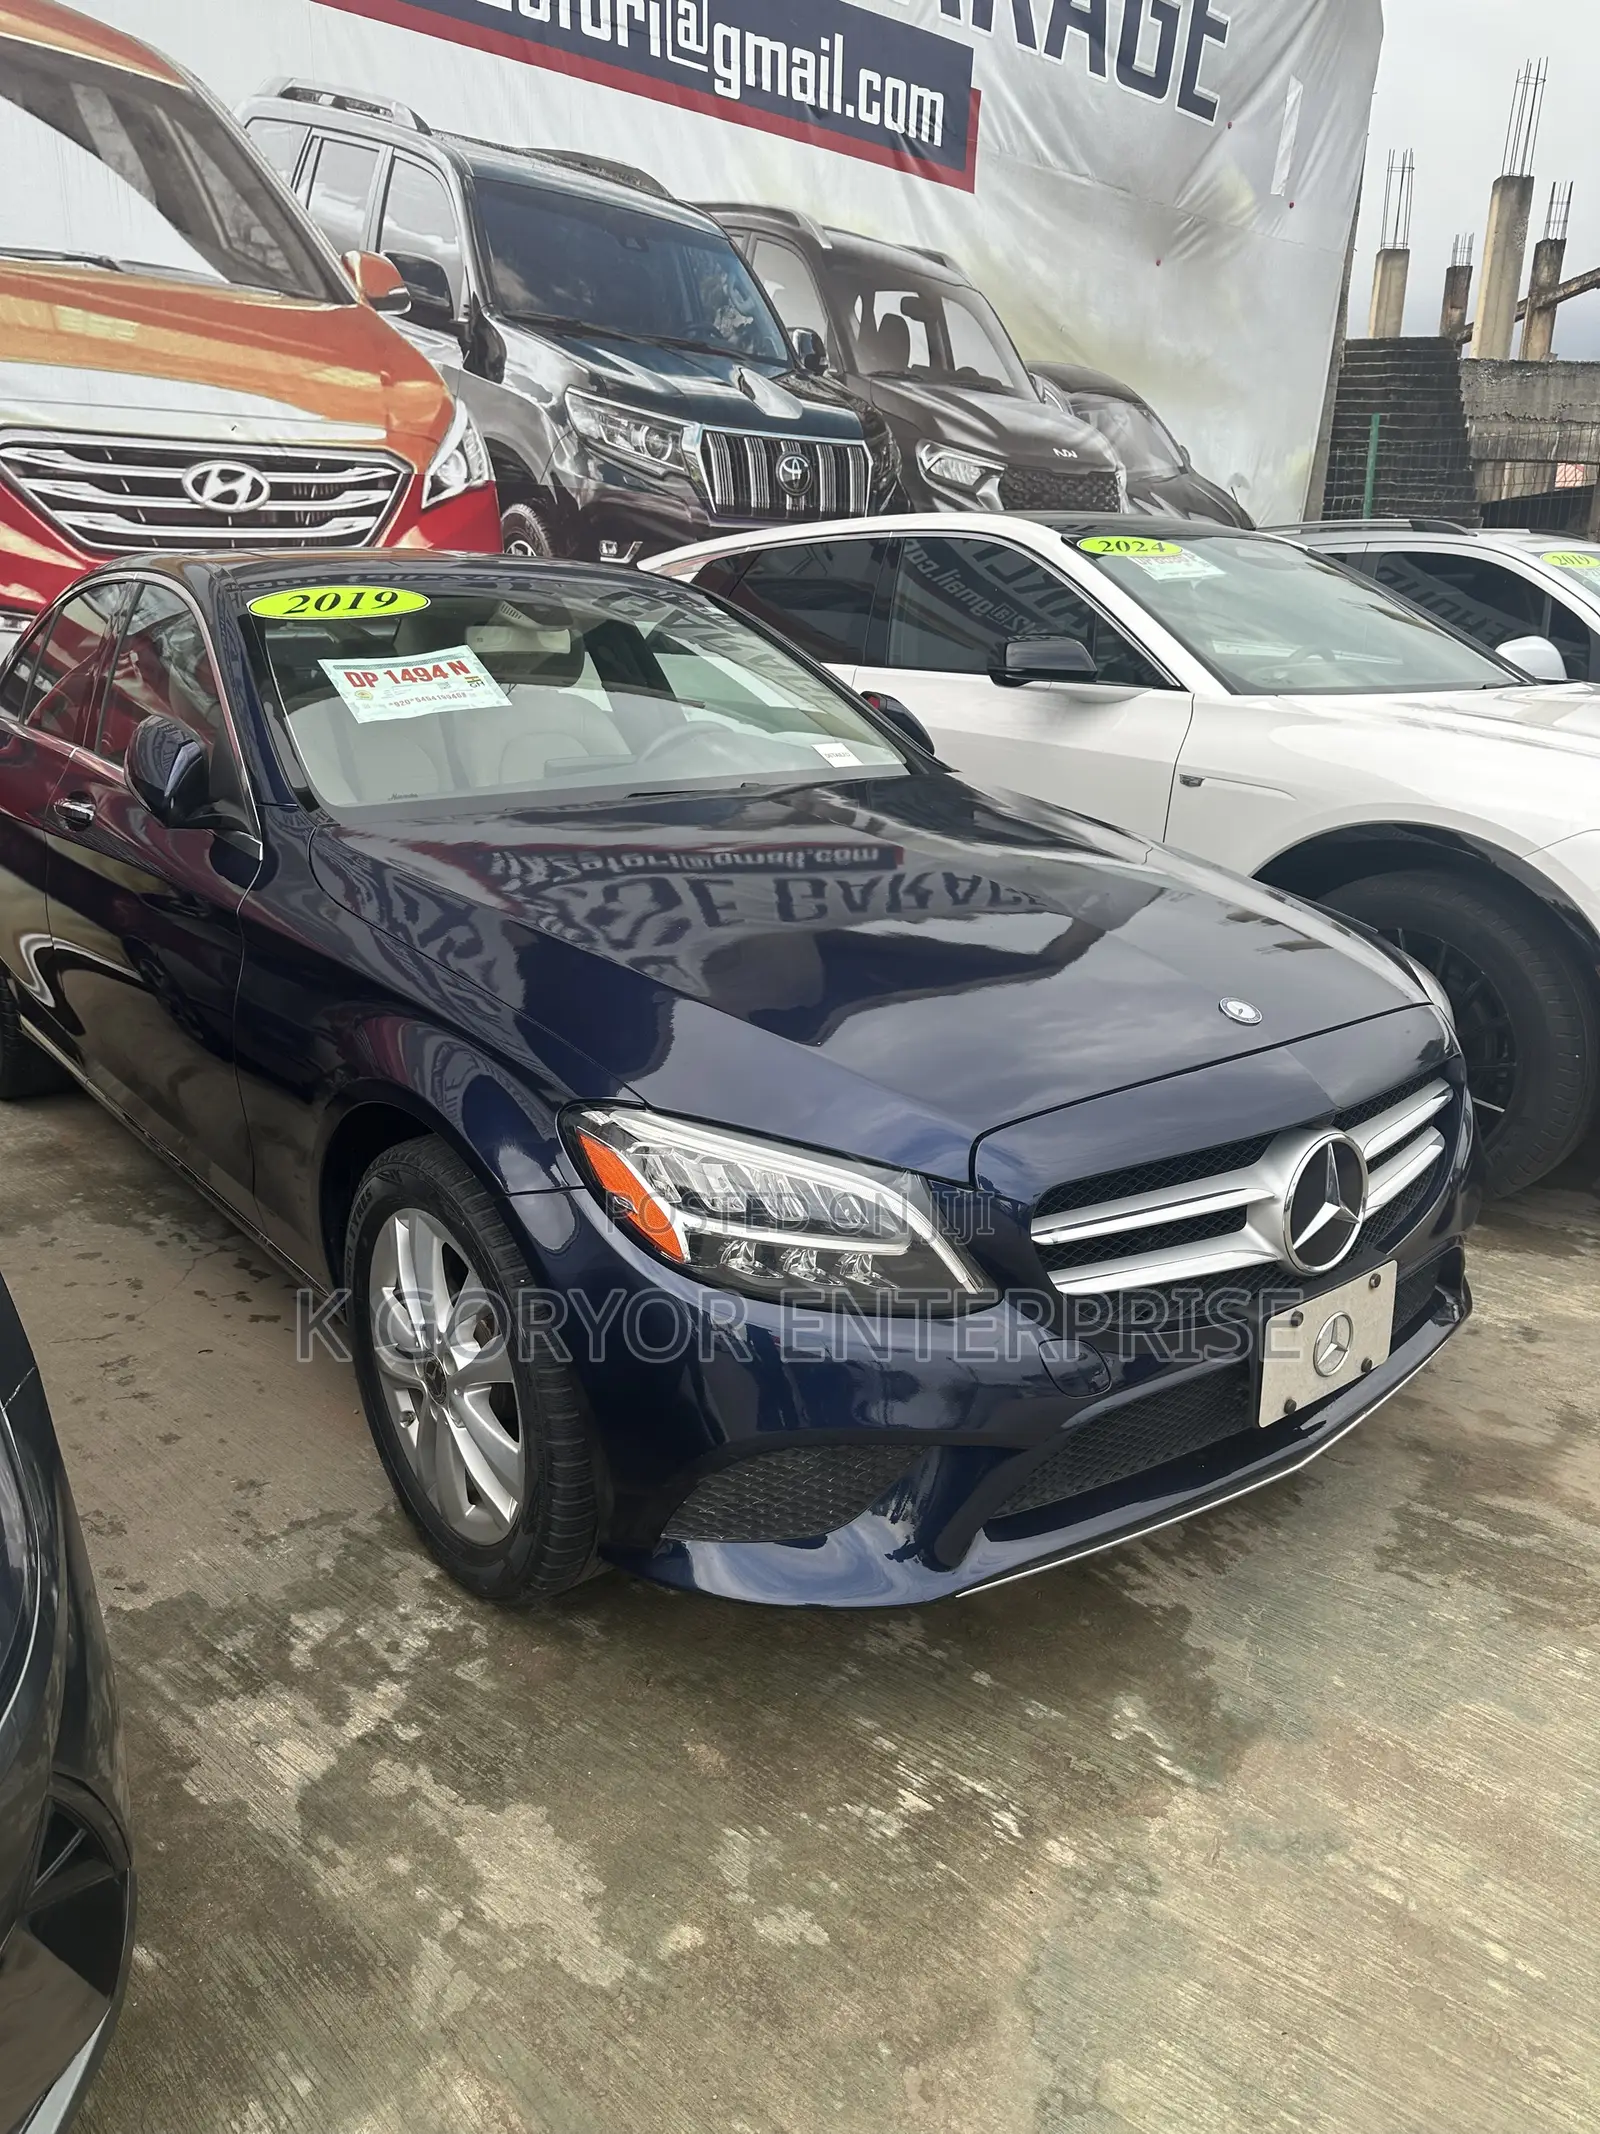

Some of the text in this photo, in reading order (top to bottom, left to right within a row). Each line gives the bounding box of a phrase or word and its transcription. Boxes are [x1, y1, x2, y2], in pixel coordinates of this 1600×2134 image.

[1097, 540, 1166, 553] 2024
[282, 590, 399, 615] 2019
[343, 659, 471, 689] DP 1494 N
